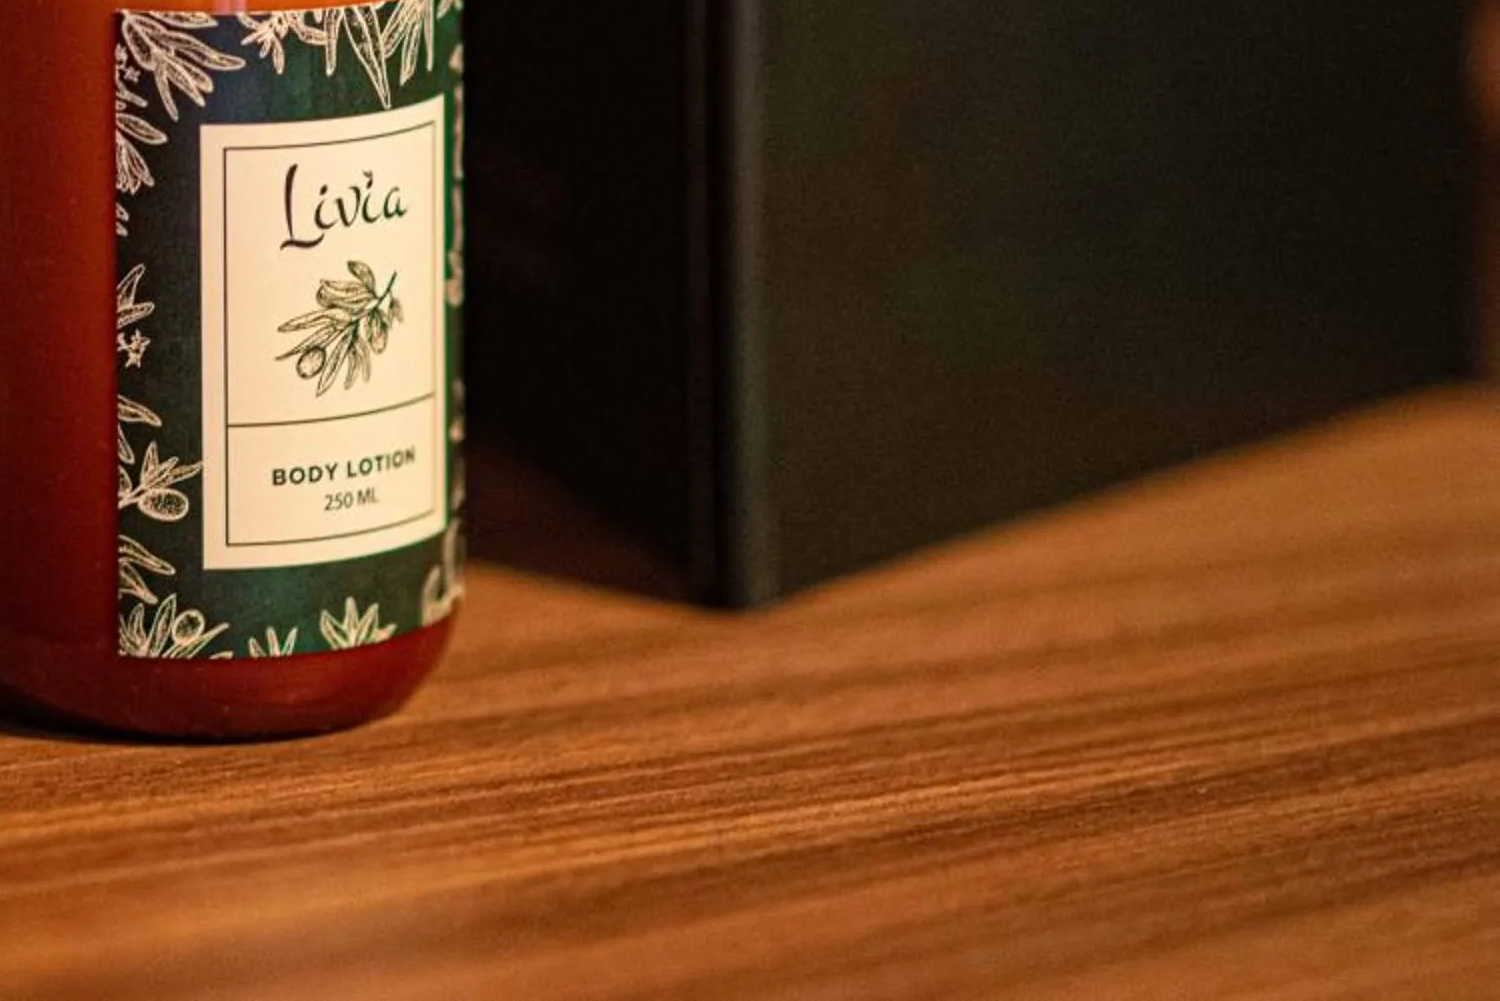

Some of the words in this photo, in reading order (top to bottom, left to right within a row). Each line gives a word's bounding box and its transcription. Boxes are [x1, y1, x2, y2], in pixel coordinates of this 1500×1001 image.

[280, 164, 407, 250] Livia
[272, 463, 338, 486] BODY
[347, 447, 415, 478] LOTION
[325, 493, 354, 511] 250
[357, 487, 378, 505] ML
